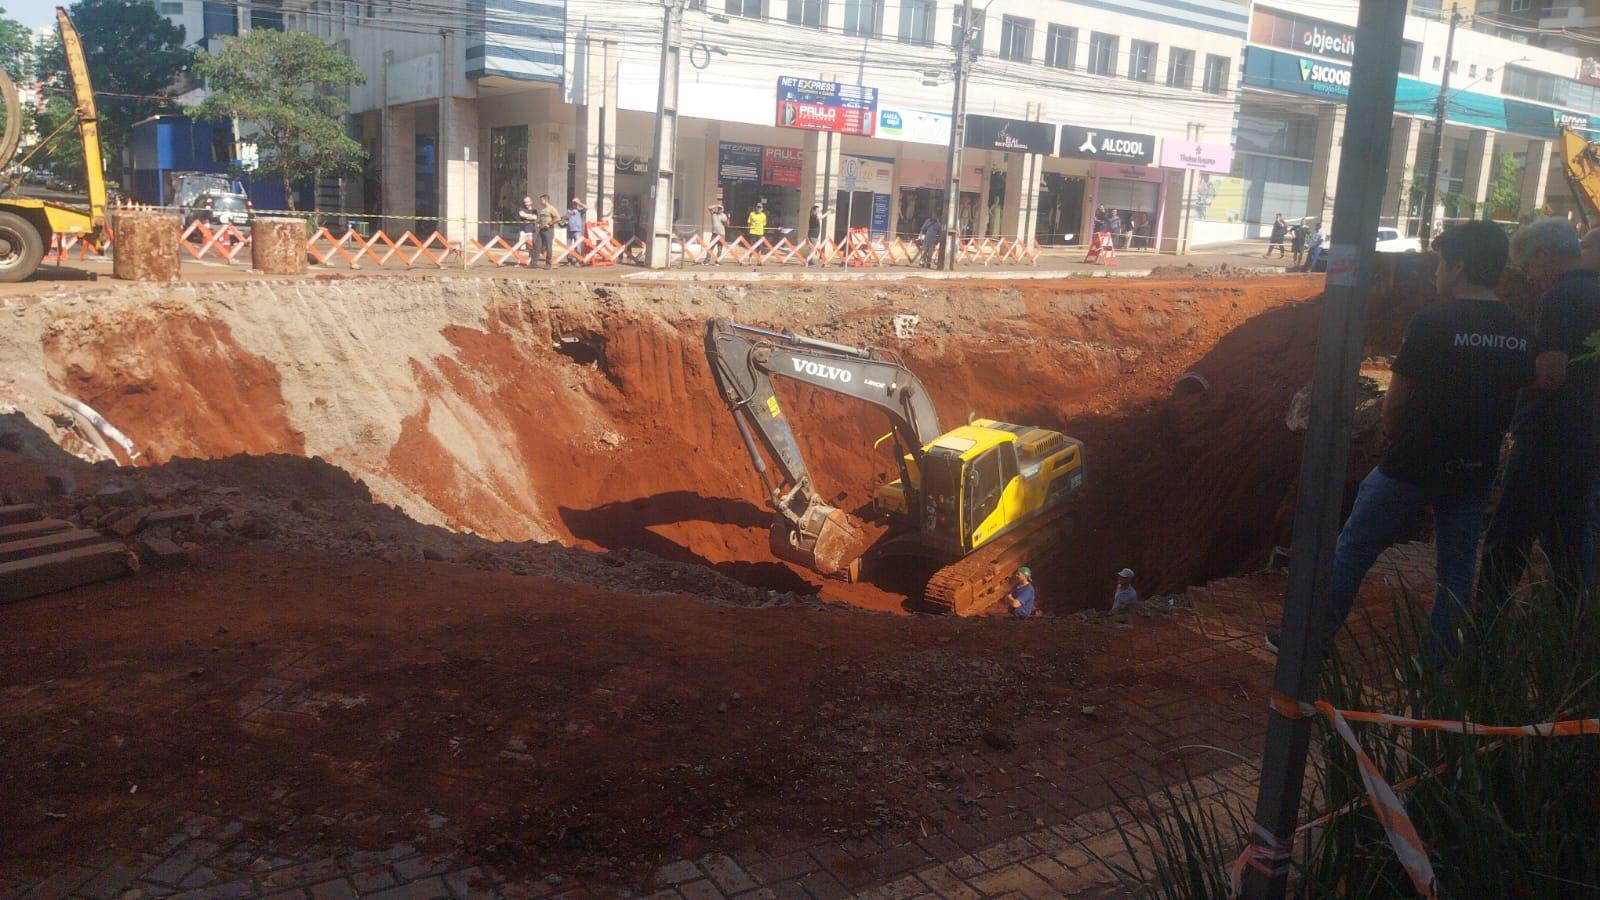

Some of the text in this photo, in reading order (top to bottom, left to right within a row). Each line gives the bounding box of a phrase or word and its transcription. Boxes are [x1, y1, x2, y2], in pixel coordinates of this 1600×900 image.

[781, 77, 797, 87] NET
[798, 80, 836, 92] EXPRESS
[1311, 64, 1351, 87] SICOOB
[799, 105, 836, 119] PAULO
[1101, 138, 1145, 156] ALCOOL
[1454, 333, 1527, 351] MONITOR
[791, 358, 852, 382] VOLVO
